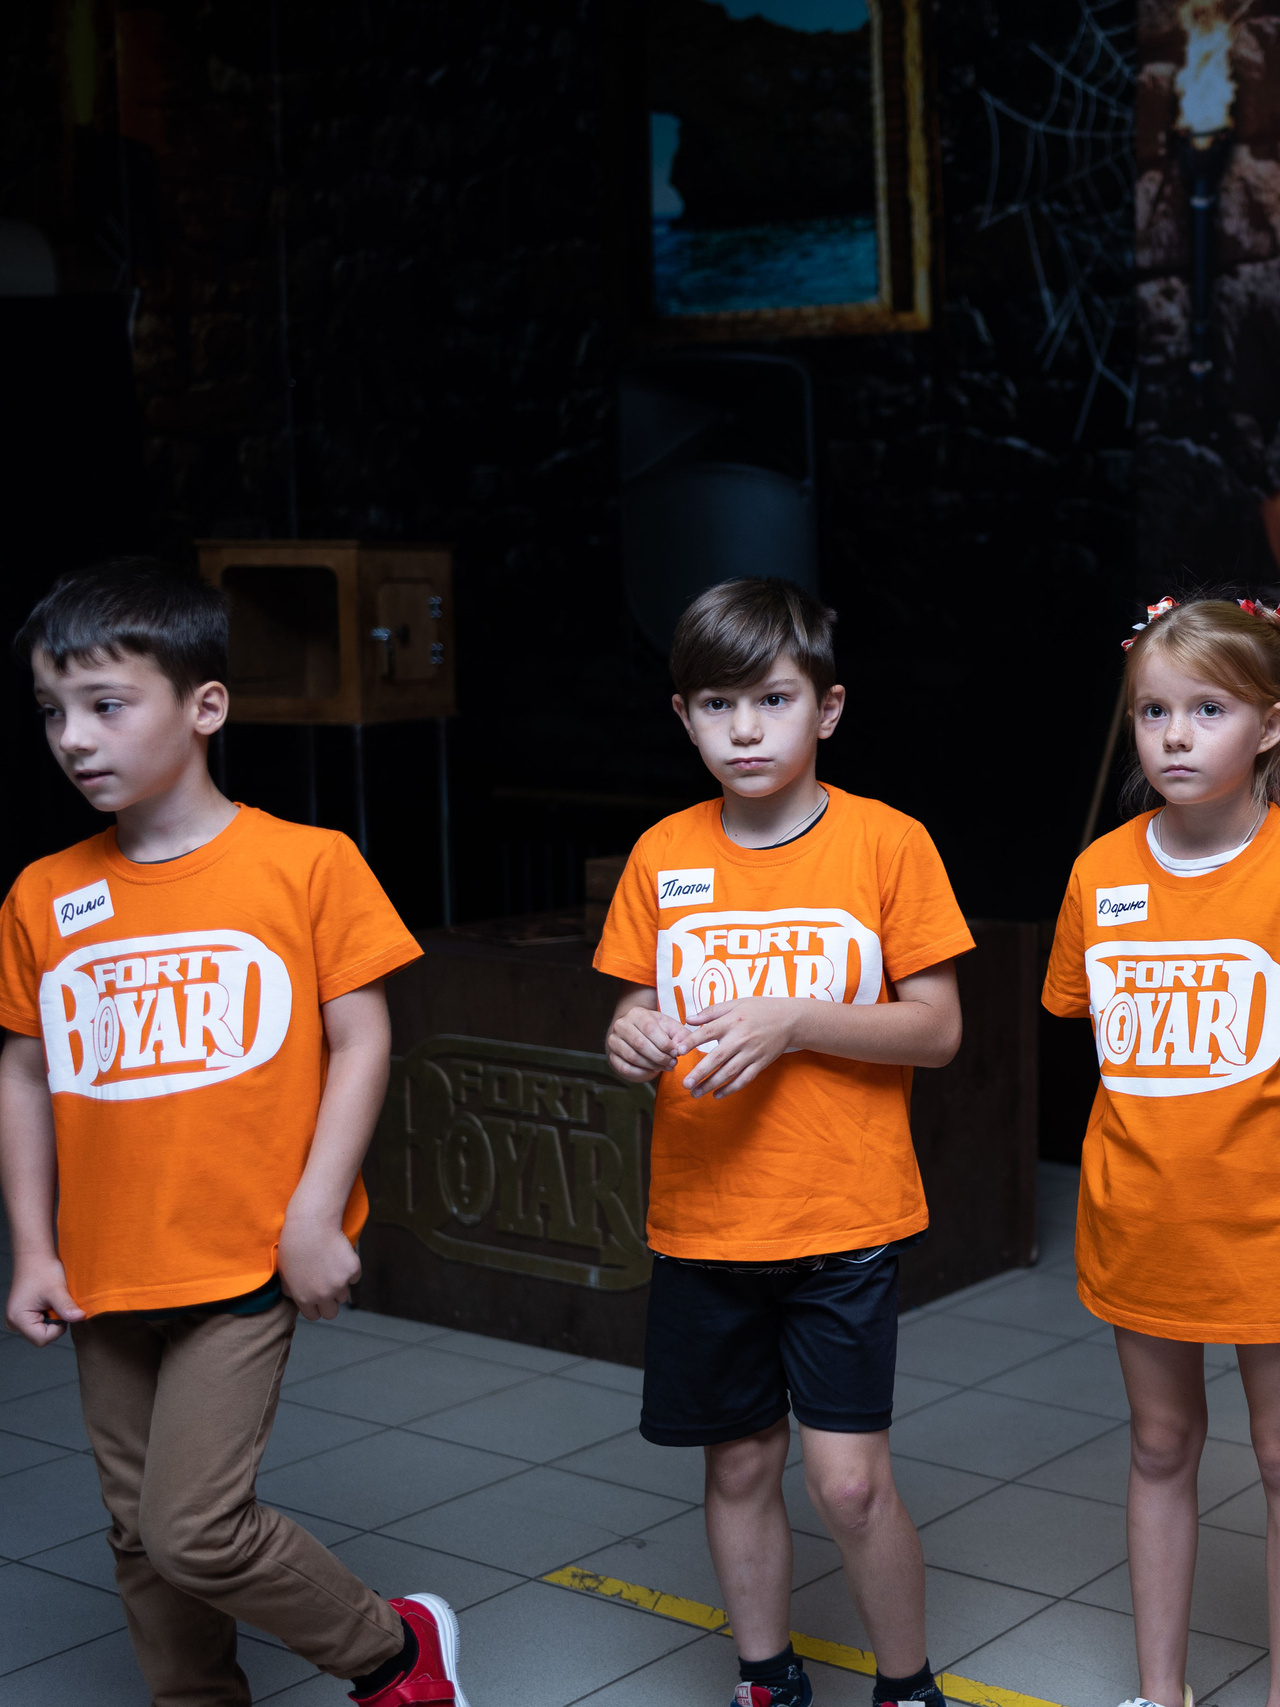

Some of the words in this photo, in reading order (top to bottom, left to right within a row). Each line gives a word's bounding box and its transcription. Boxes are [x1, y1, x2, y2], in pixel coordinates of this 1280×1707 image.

[660, 879, 710, 899] Платон
[61, 895, 106, 923] Дима
[1098, 899, 1146, 917] Дарина
[704, 926, 819, 956] FORT
[93, 951, 213, 994] FORT
[1115, 959, 1224, 988] FORT
[39, 949, 292, 1093] BOYARD
[450, 1058, 595, 1124] FORT
